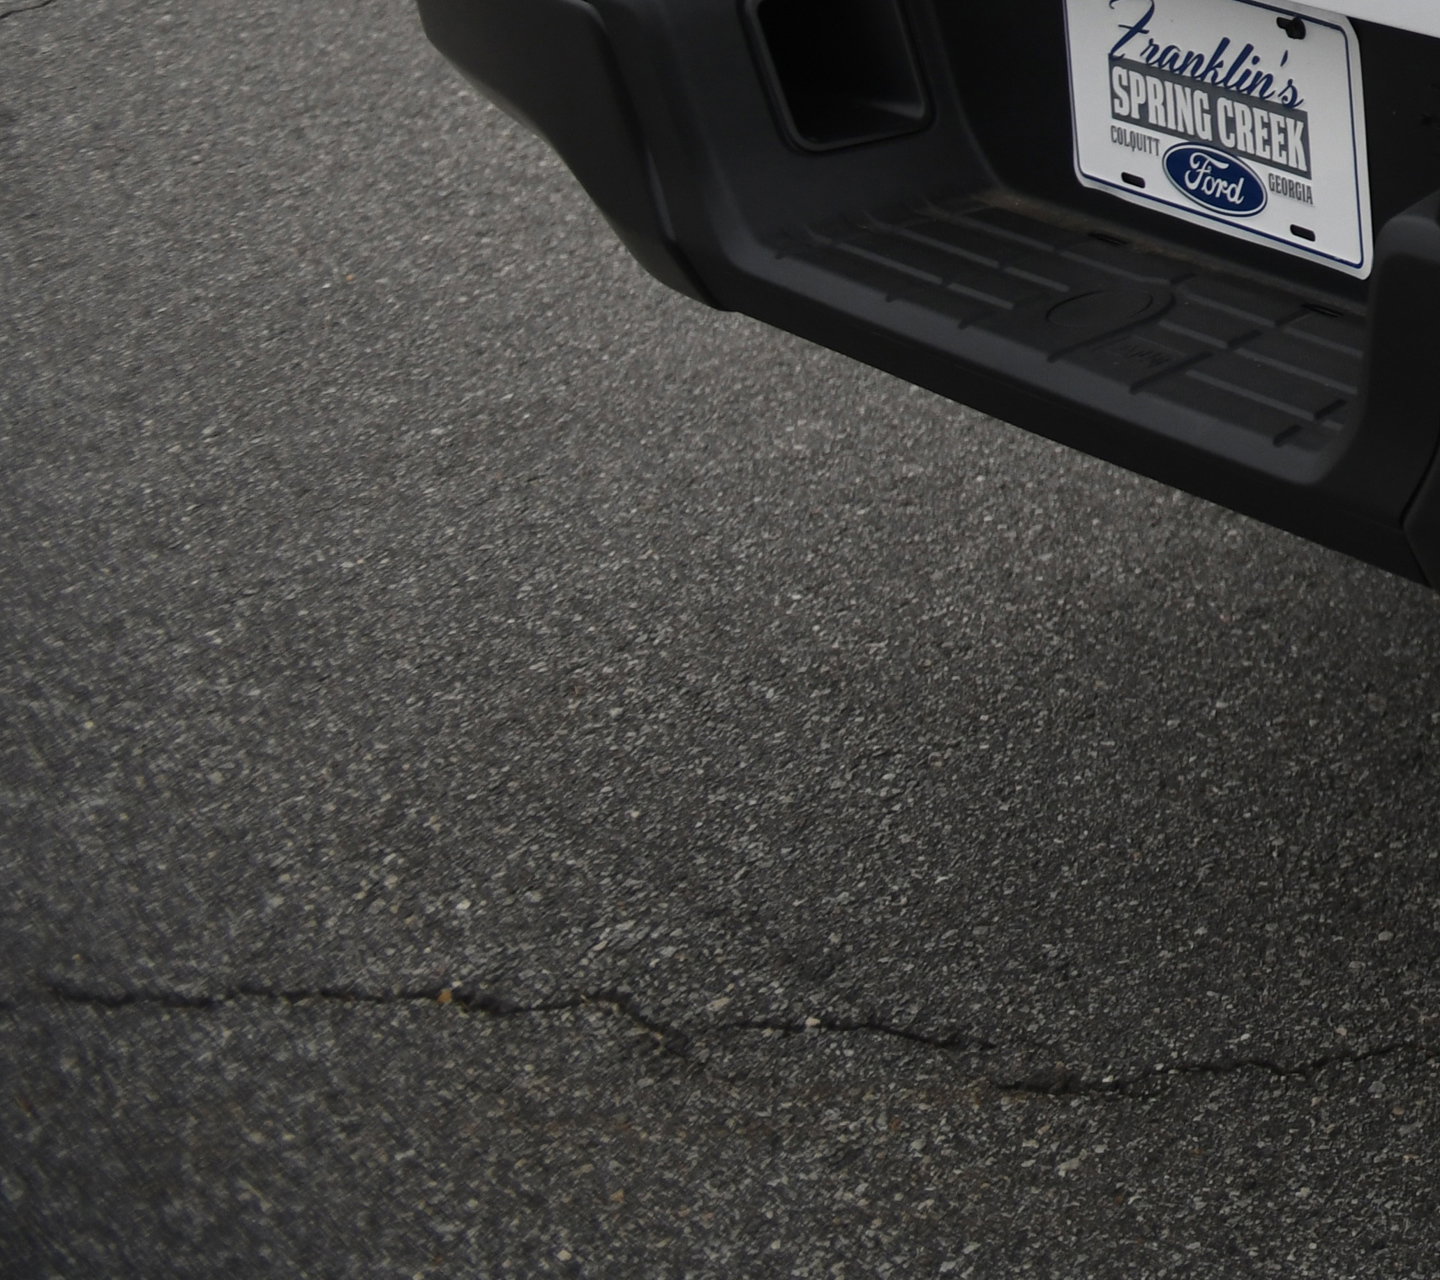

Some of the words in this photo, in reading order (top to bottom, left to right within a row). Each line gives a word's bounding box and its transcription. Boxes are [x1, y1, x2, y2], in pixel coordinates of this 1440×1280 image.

[1109, 124, 1162, 158] COLQUITT
[1111, 65, 1213, 142] SPRING
[1216, 96, 1310, 173] CREEK
[1184, 151, 1245, 206] Ford
[1267, 172, 1315, 207] GEORGIA
